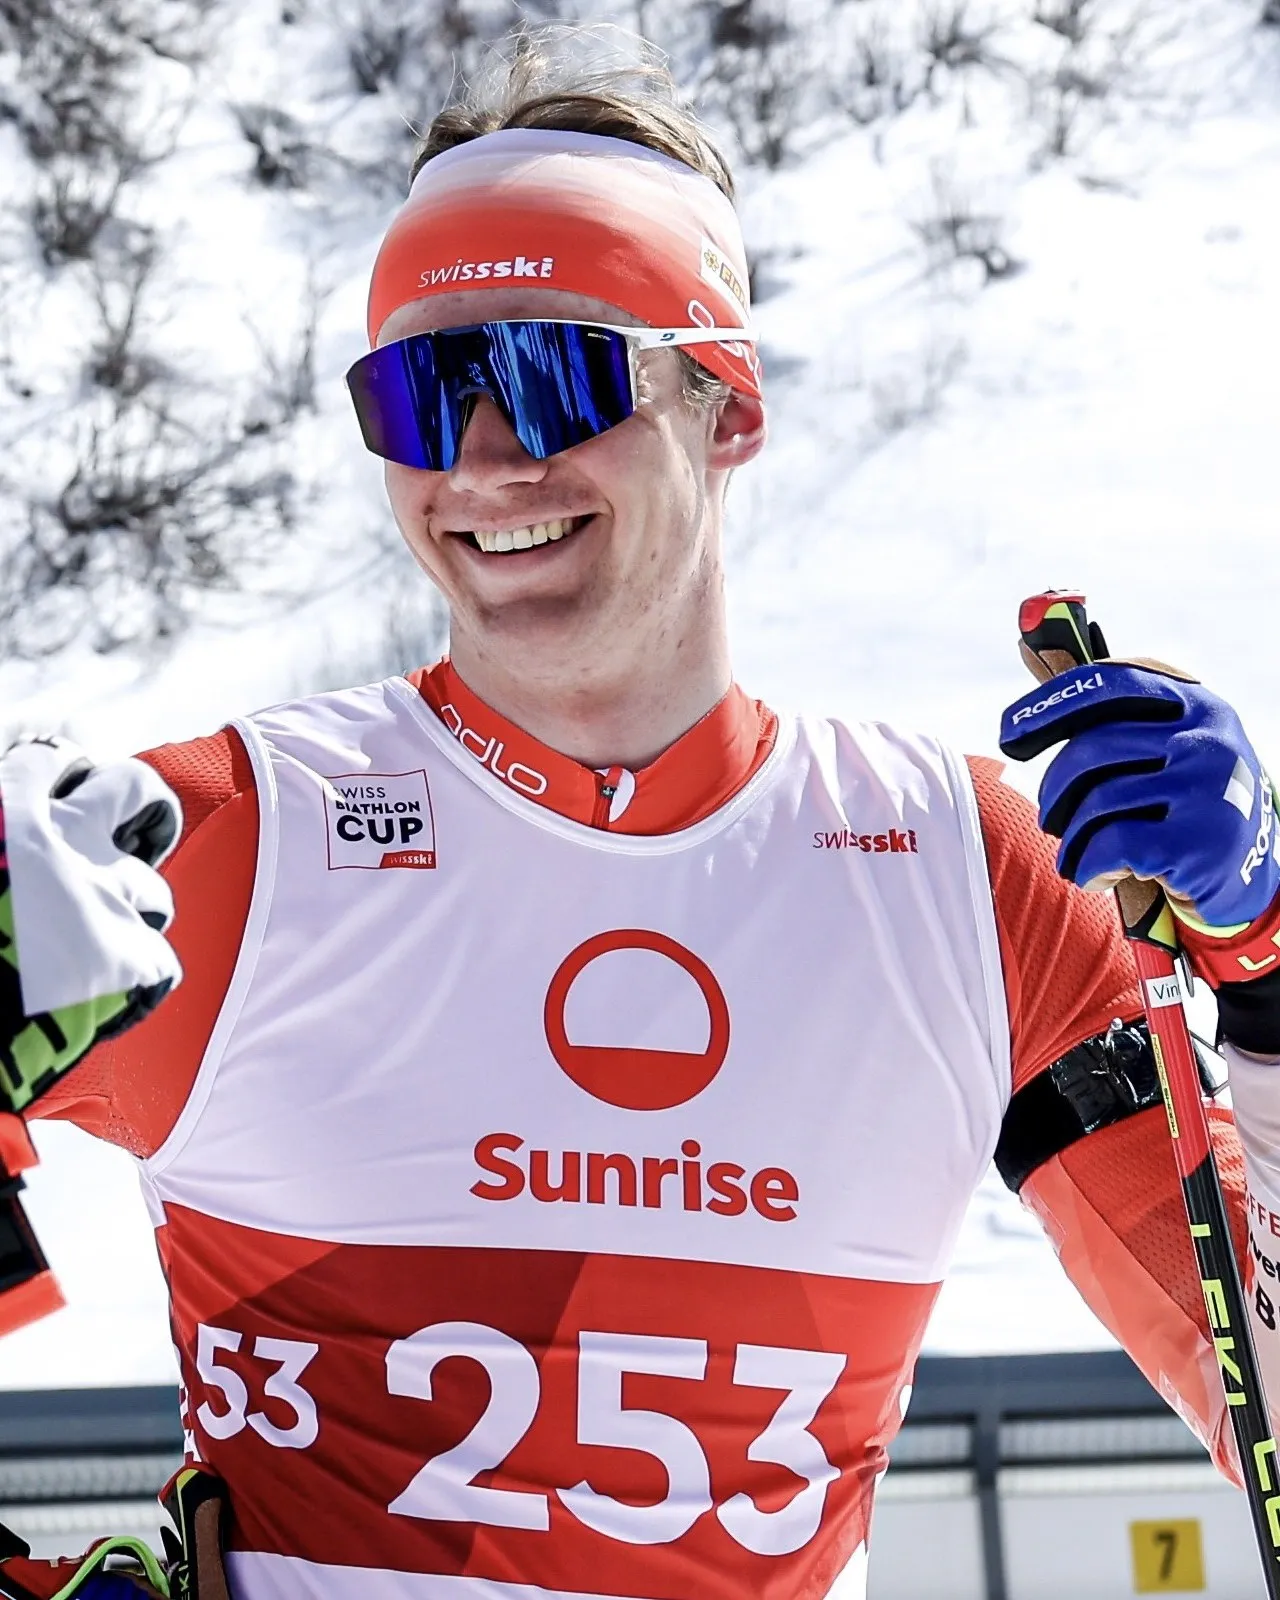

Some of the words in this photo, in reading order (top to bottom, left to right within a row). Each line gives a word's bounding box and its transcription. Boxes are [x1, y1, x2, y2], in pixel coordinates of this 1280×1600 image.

[417, 256, 554, 288] swissski
[336, 814, 424, 845] CUP
[469, 1132, 800, 1223] Sunrise
[384, 1320, 848, 1557] 253
[1153, 1529, 1179, 1581] 7
